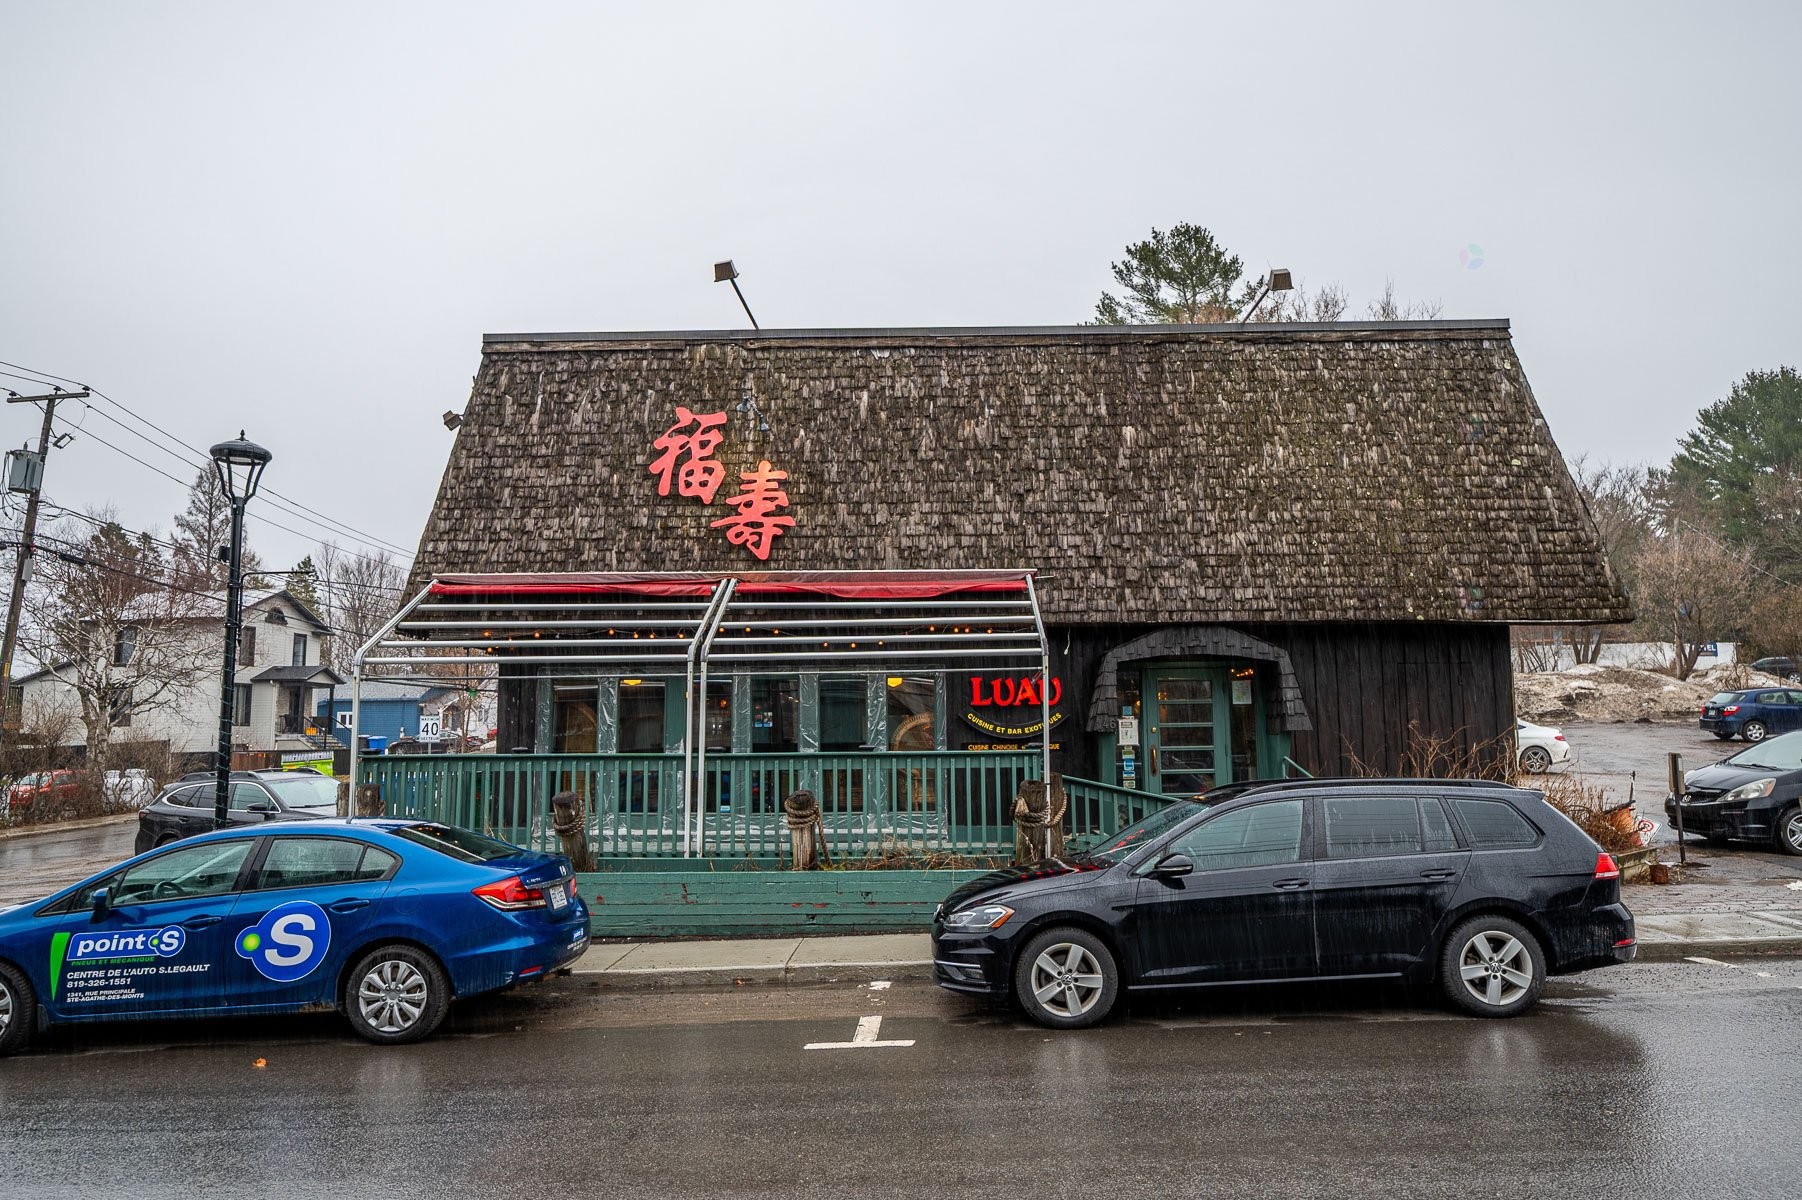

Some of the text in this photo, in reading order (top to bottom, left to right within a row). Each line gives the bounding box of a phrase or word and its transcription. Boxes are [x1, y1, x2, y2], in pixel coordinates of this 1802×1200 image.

[970, 677, 1062, 707] LUAU
[421, 722, 438, 736] 40
[967, 713, 994, 731] CUISINE
[1007, 727, 1022, 735] BAR
[1025, 712, 1062, 733] EXOTUES
[77, 930, 180, 957] point S
[265, 913, 316, 967] S
[67, 964, 210, 979] CENTRE DE L'AUTO S.LEGAULT
[66, 978, 131, 988] 819-326-1551
[66, 993, 144, 1003] STE-AGATHE-DES-MONTS
